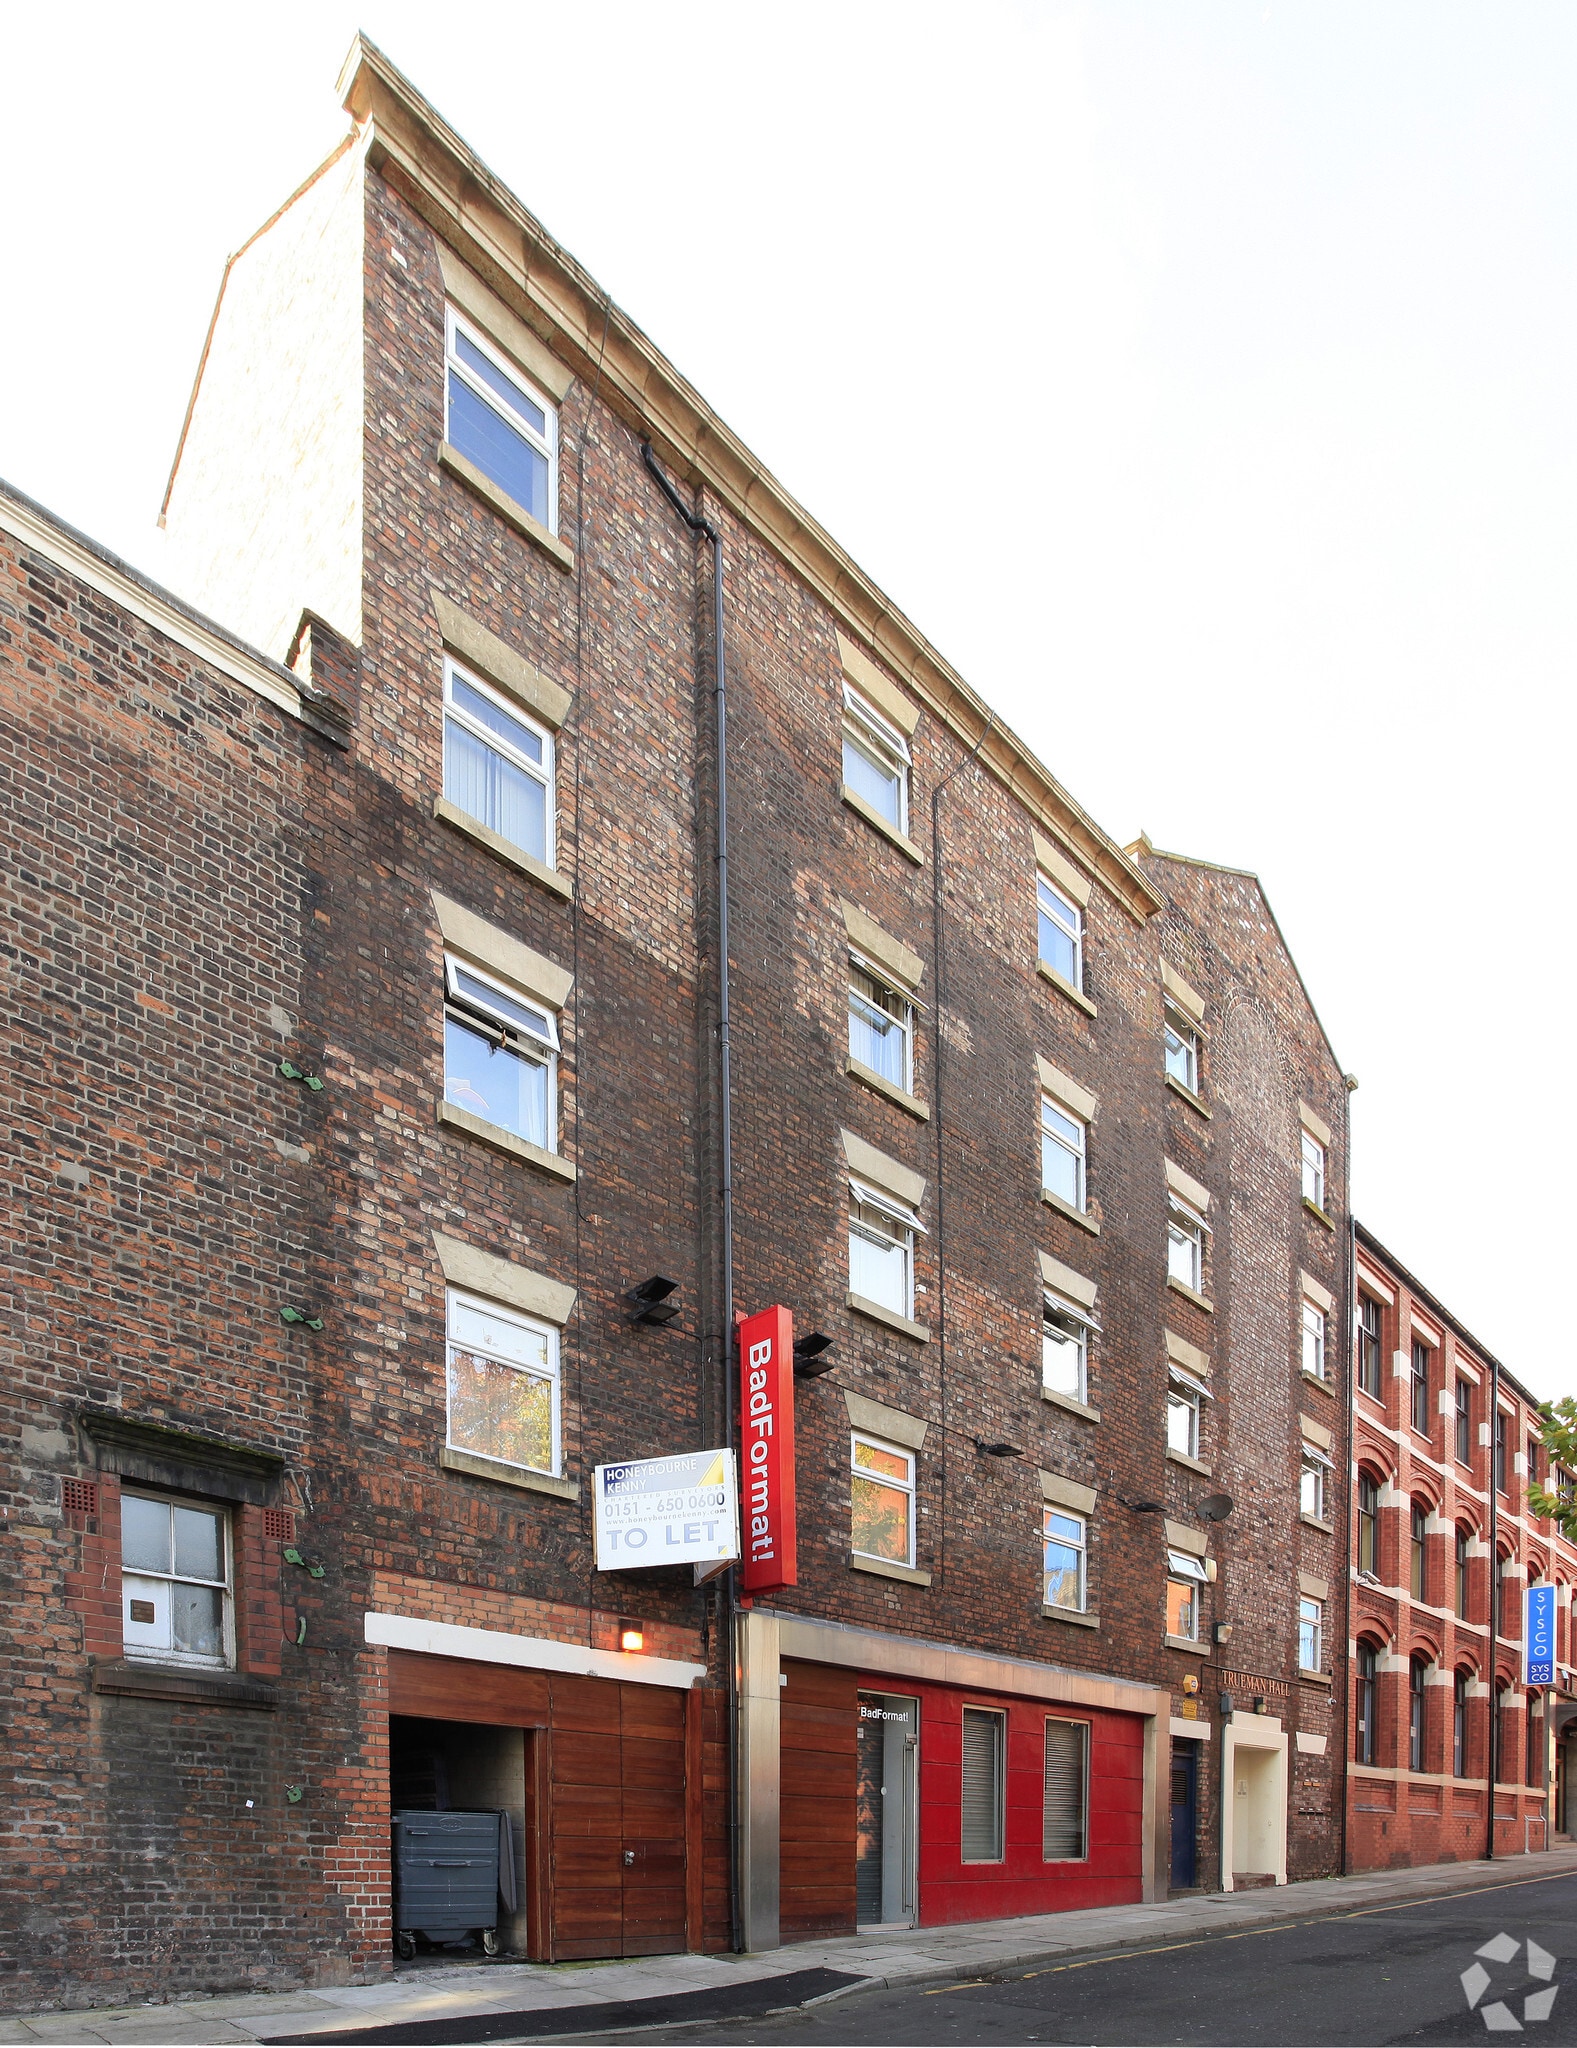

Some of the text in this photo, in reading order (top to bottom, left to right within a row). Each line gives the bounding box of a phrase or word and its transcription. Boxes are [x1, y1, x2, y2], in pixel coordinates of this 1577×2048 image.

[749, 1337, 774, 1563] BadFormat!
[606, 1459, 697, 1481] HONEYBOURNE
[604, 1484, 725, 1503] CHARTERED SURVEYORS
[607, 1480, 647, 1494] KENNY
[604, 1501, 638, 1518] 0151
[657, 1497, 683, 1513] 650
[688, 1491, 725, 1509] 0600
[606, 1507, 727, 1526] www.honeybournekenny.com
[605, 1520, 720, 1551] TO LET
[1533, 1591, 1547, 1656] SYSCO
[1530, 1663, 1550, 1673] SYS
[1531, 1672, 1549, 1682] CO
[1222, 1670, 1291, 1697] TRUEMAN HALL
[860, 1706, 909, 1722] BadFormat!
